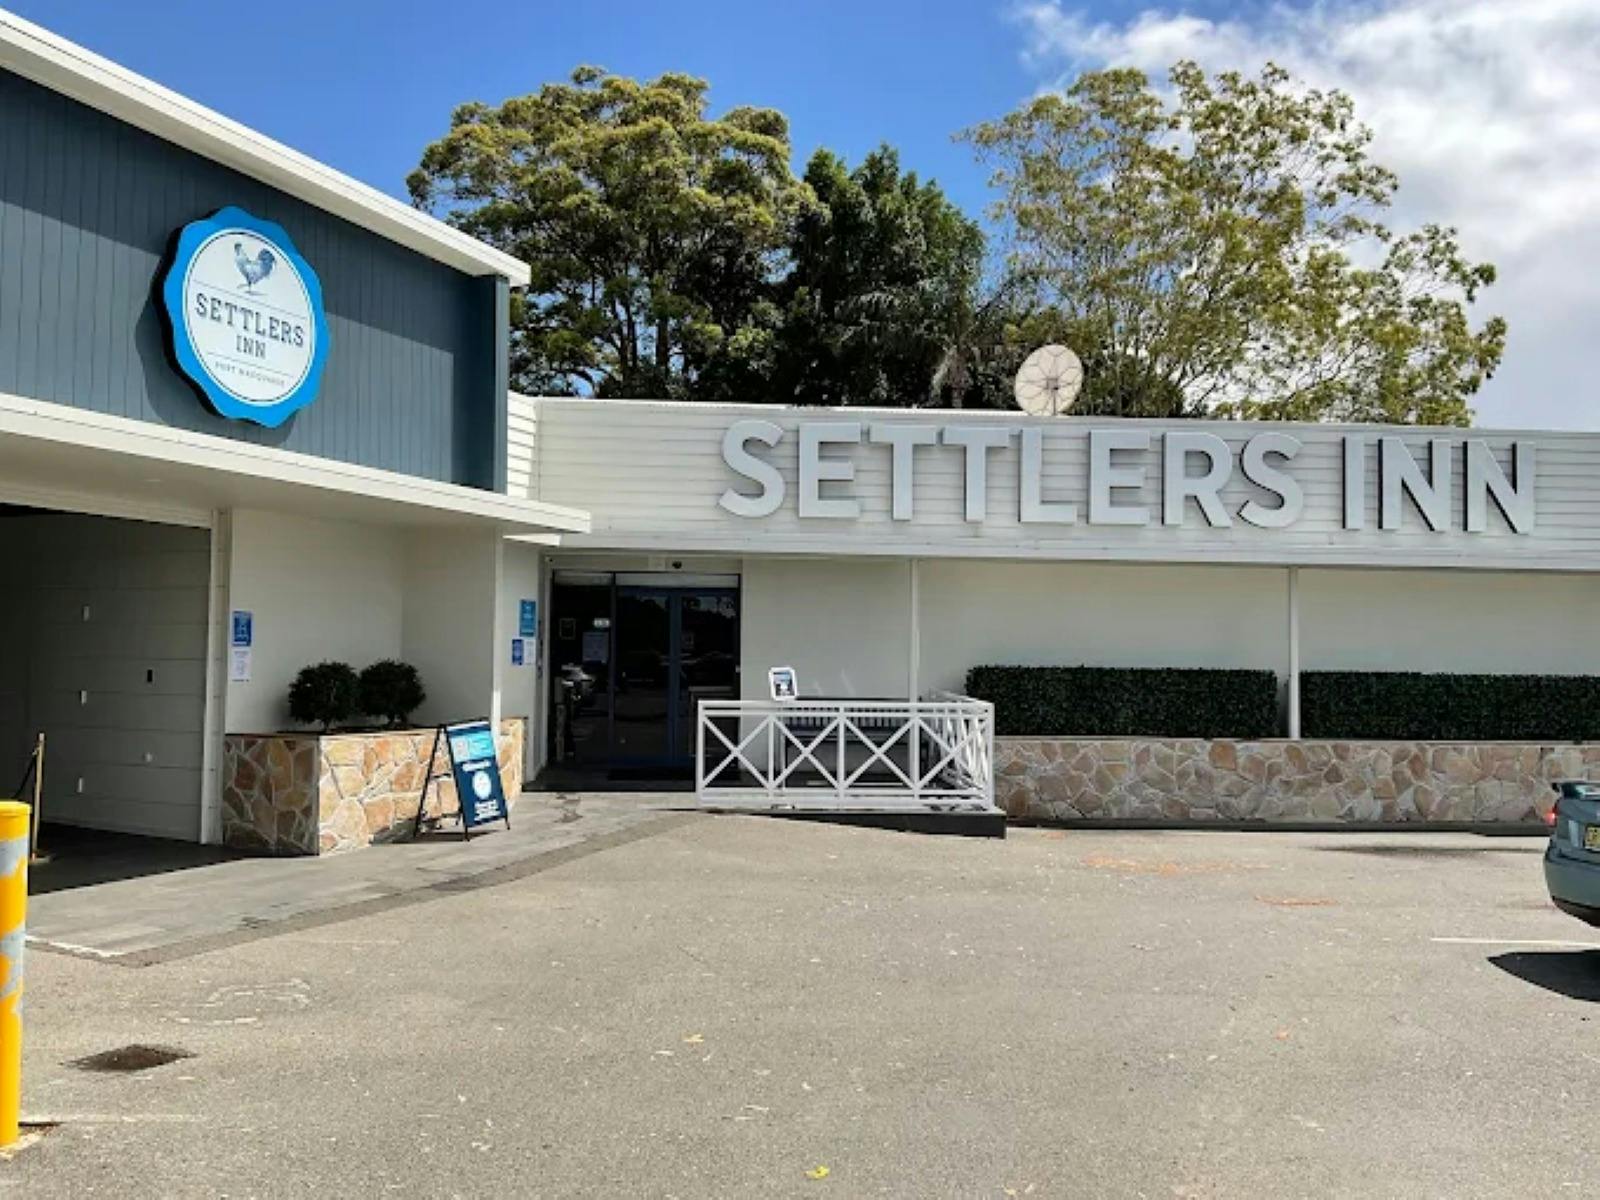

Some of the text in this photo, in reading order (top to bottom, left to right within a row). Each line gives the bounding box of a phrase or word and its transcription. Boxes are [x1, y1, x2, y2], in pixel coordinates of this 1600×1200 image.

[195, 292, 304, 347] SETTLERS
[235, 335, 266, 359] INN
[719, 420, 1535, 534] SETTLERS INN
